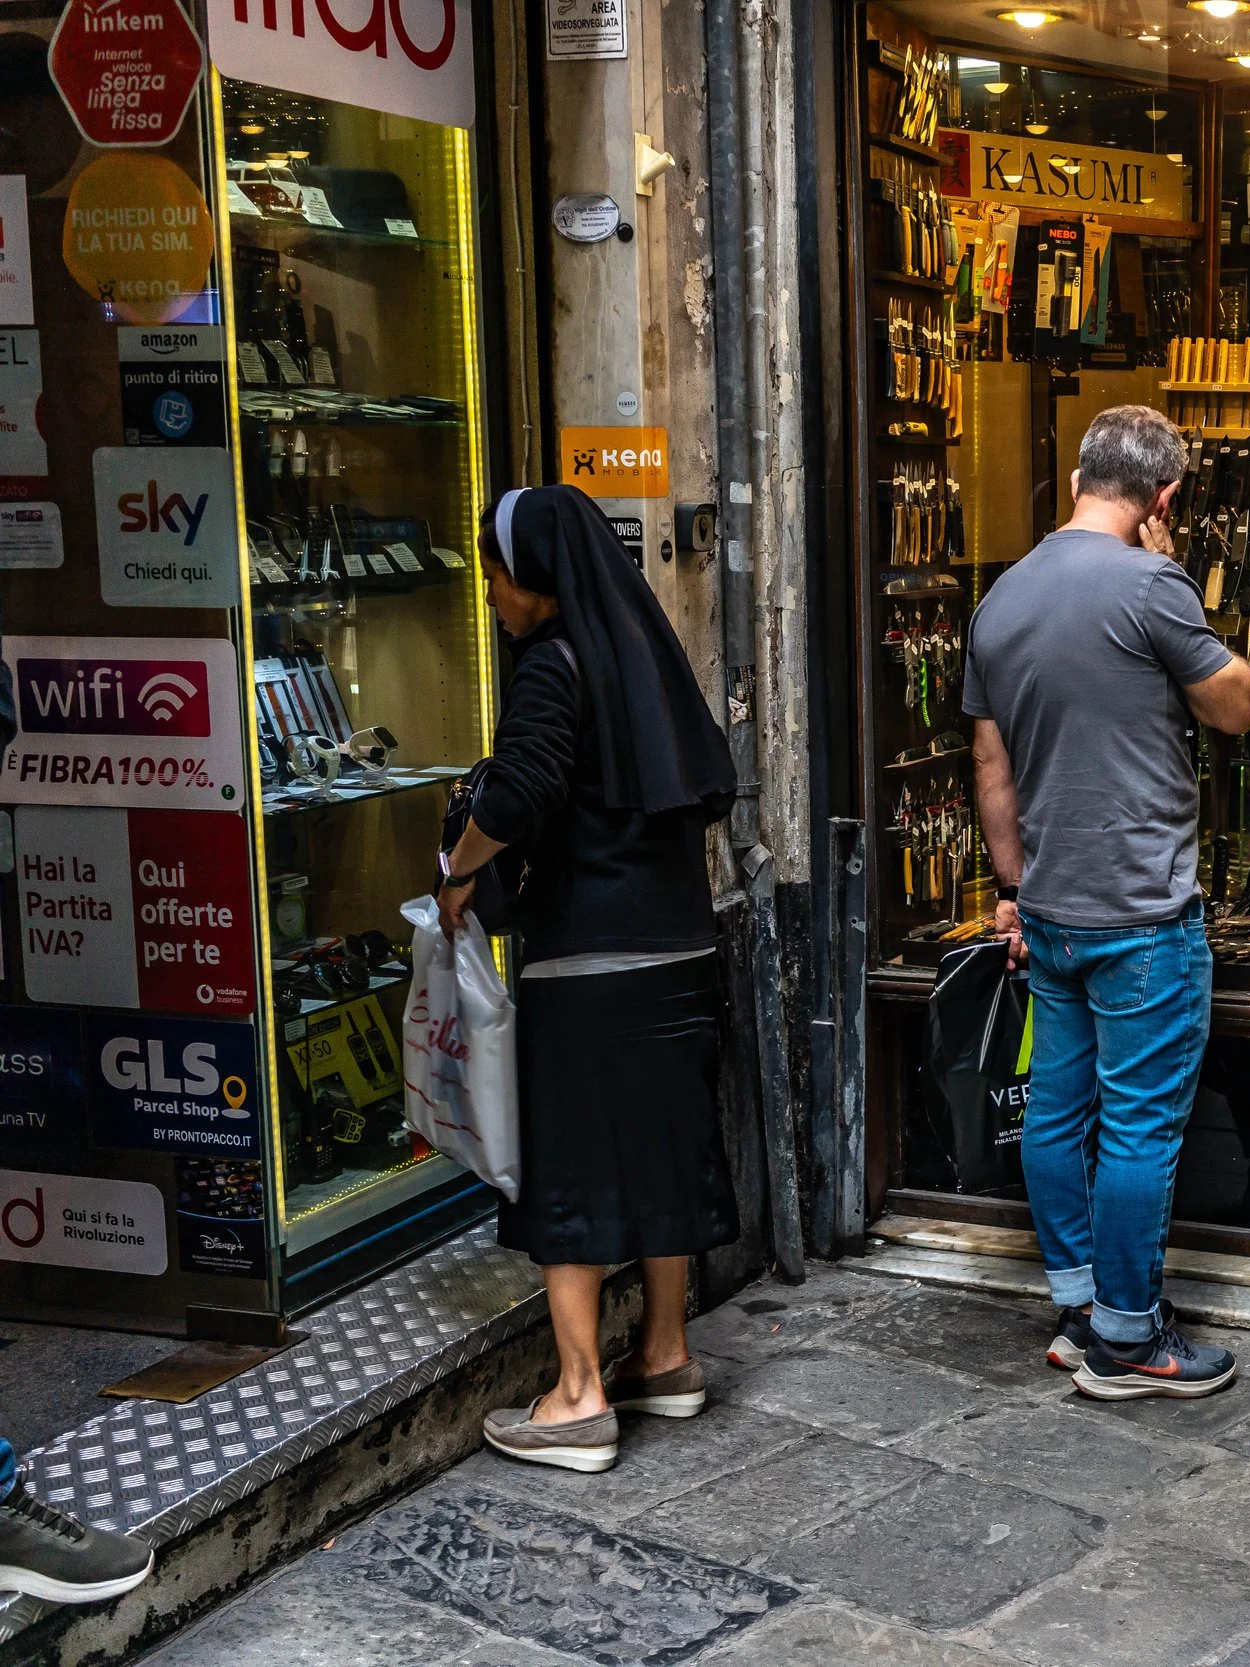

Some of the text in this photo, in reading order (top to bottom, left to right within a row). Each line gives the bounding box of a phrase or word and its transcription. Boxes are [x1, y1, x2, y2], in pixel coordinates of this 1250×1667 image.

[591, 1, 617, 14] AREA
[84, 9, 163, 33] linkem
[552, 17, 619, 30] VIDEOSORVEGLIATA
[94, 49, 143, 61] Internet
[112, 61, 152, 74] veloce
[100, 72, 166, 92] Senza
[87, 88, 141, 109] linea
[111, 108, 163, 130] fissa
[981, 146, 1145, 205] KASUMI
[71, 207, 197, 228] RICHIEDI QUI
[78, 231, 194, 252] LA TUA SIM.
[1048, 228, 1077, 240] NEBO
[141, 333, 197, 347] amazon
[124, 369, 218, 387] punto di ritiro
[118, 480, 209, 547] sky
[124, 563, 212, 584] Chiedi qui.
[30, 668, 125, 719] wifi
[24, 854, 96, 883] Hai la
[138, 859, 186, 888] Qui
[26, 892, 112, 922] Partita
[141, 898, 233, 928] offerte
[28, 927, 85, 957] IVA?
[144, 940, 220, 967] per te
[216, 988, 247, 997] vodafone
[101, 1036, 220, 1096] GLS
[134, 1098, 219, 1120] Parcel Shop
[25, 1112, 46, 1128] TV
[153, 1128, 252, 1147] BY PRONTOPACCO.IT
[998, 1127, 1023, 1138] MILANO
[62, 1208, 135, 1228] Qui si fa la
[63, 1226, 145, 1246] Rivoluzione
